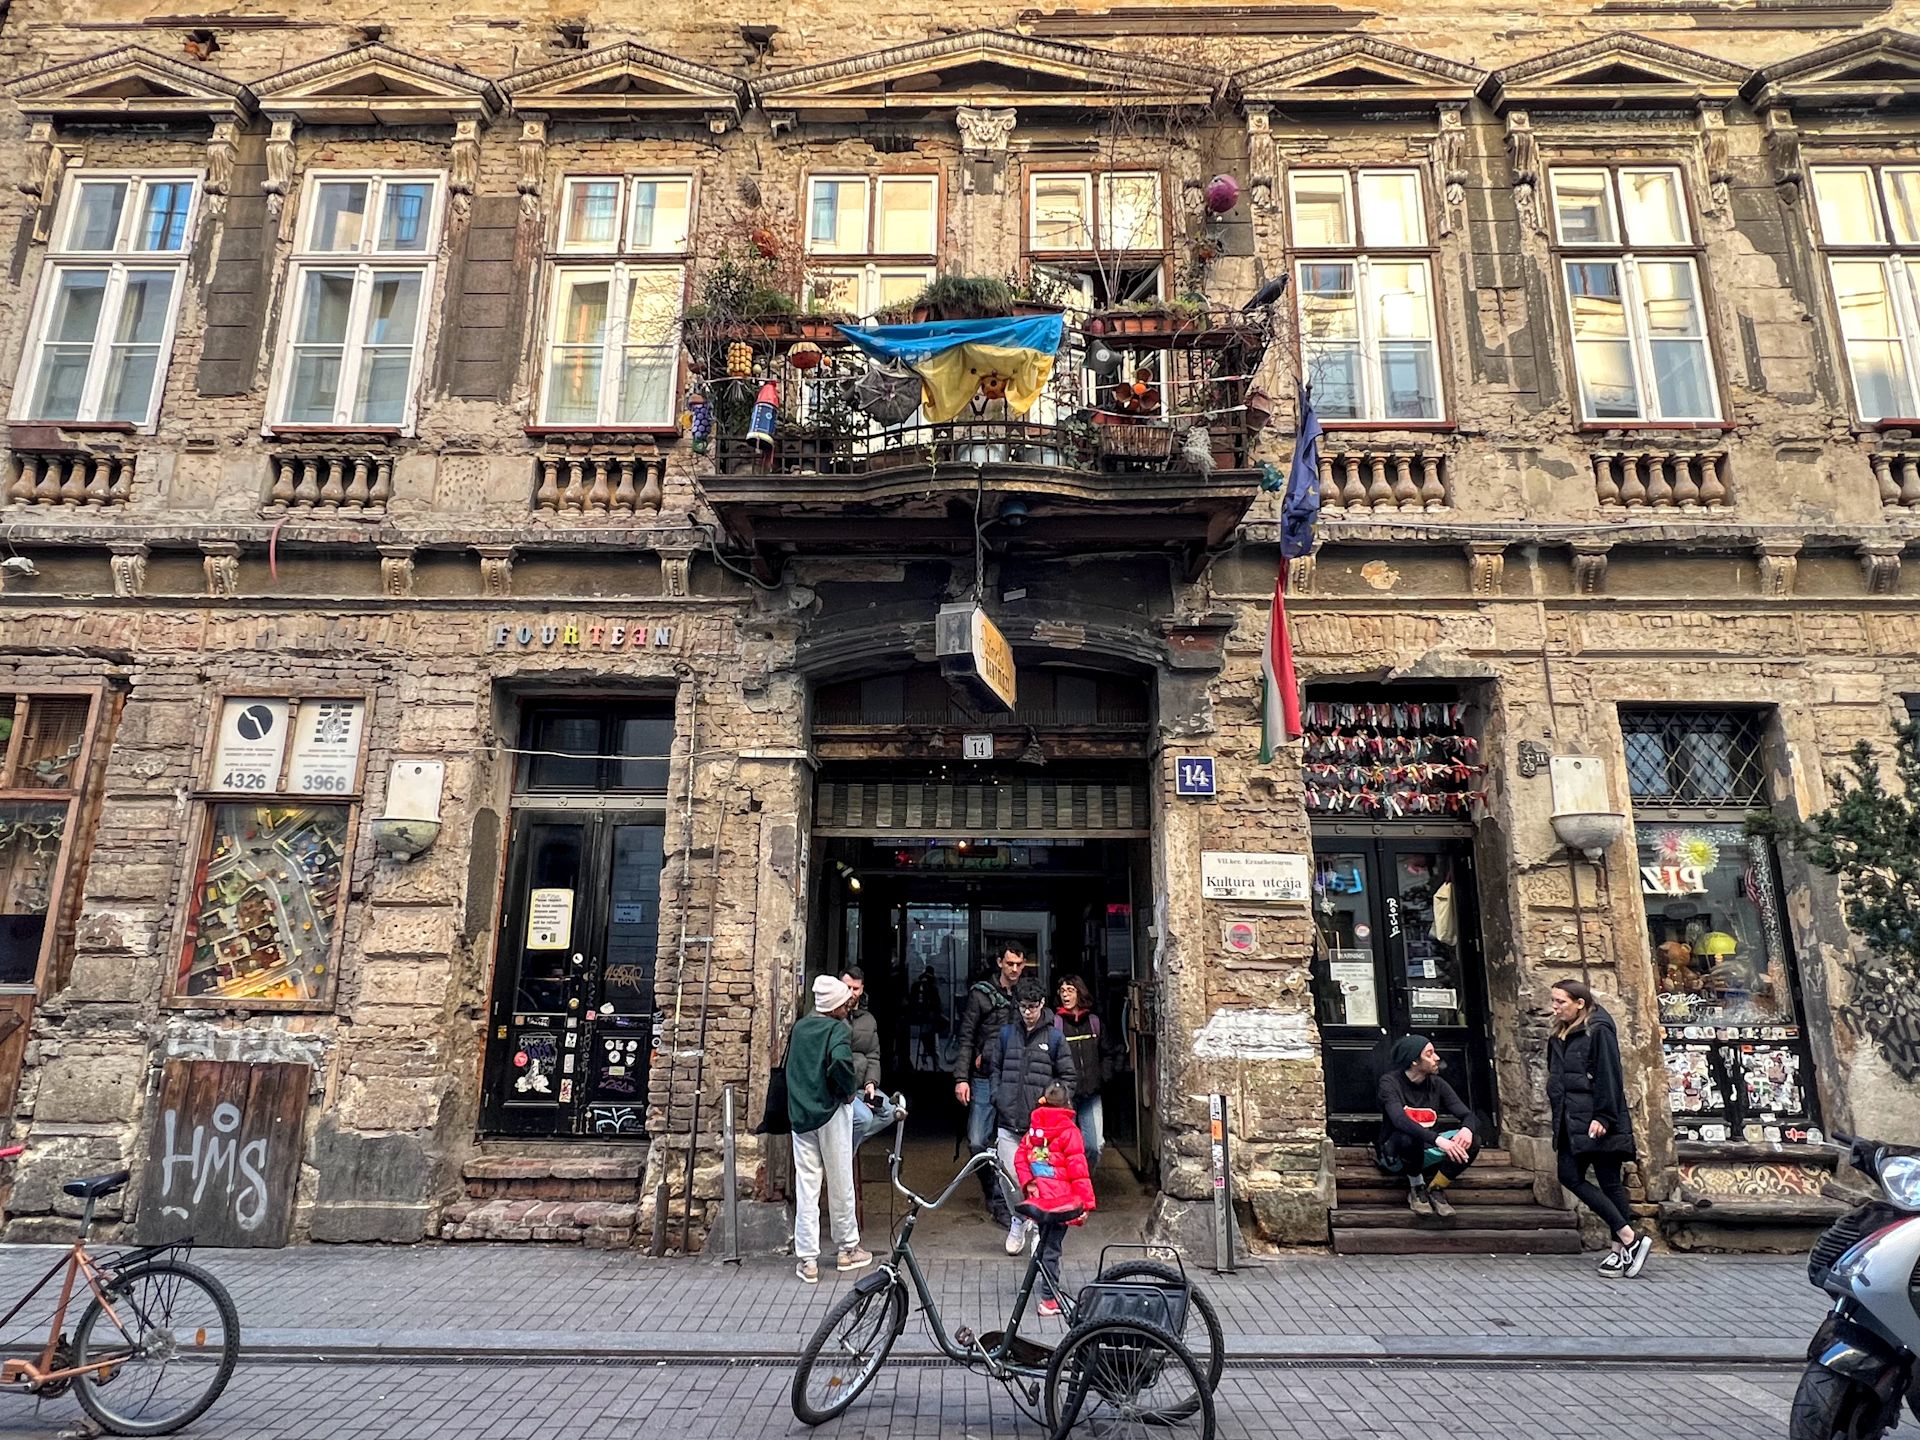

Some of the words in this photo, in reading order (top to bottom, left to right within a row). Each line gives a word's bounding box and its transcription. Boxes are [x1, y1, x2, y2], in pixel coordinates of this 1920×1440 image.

[495, 623, 672, 646] FOURTEEN
[973, 742, 984, 756] 14
[223, 772, 267, 790] 4326
[302, 774, 347, 792] 3966
[1182, 764, 1209, 787] 14
[1206, 876, 1255, 888] Kultúra
[1262, 877, 1302, 890] utcája
